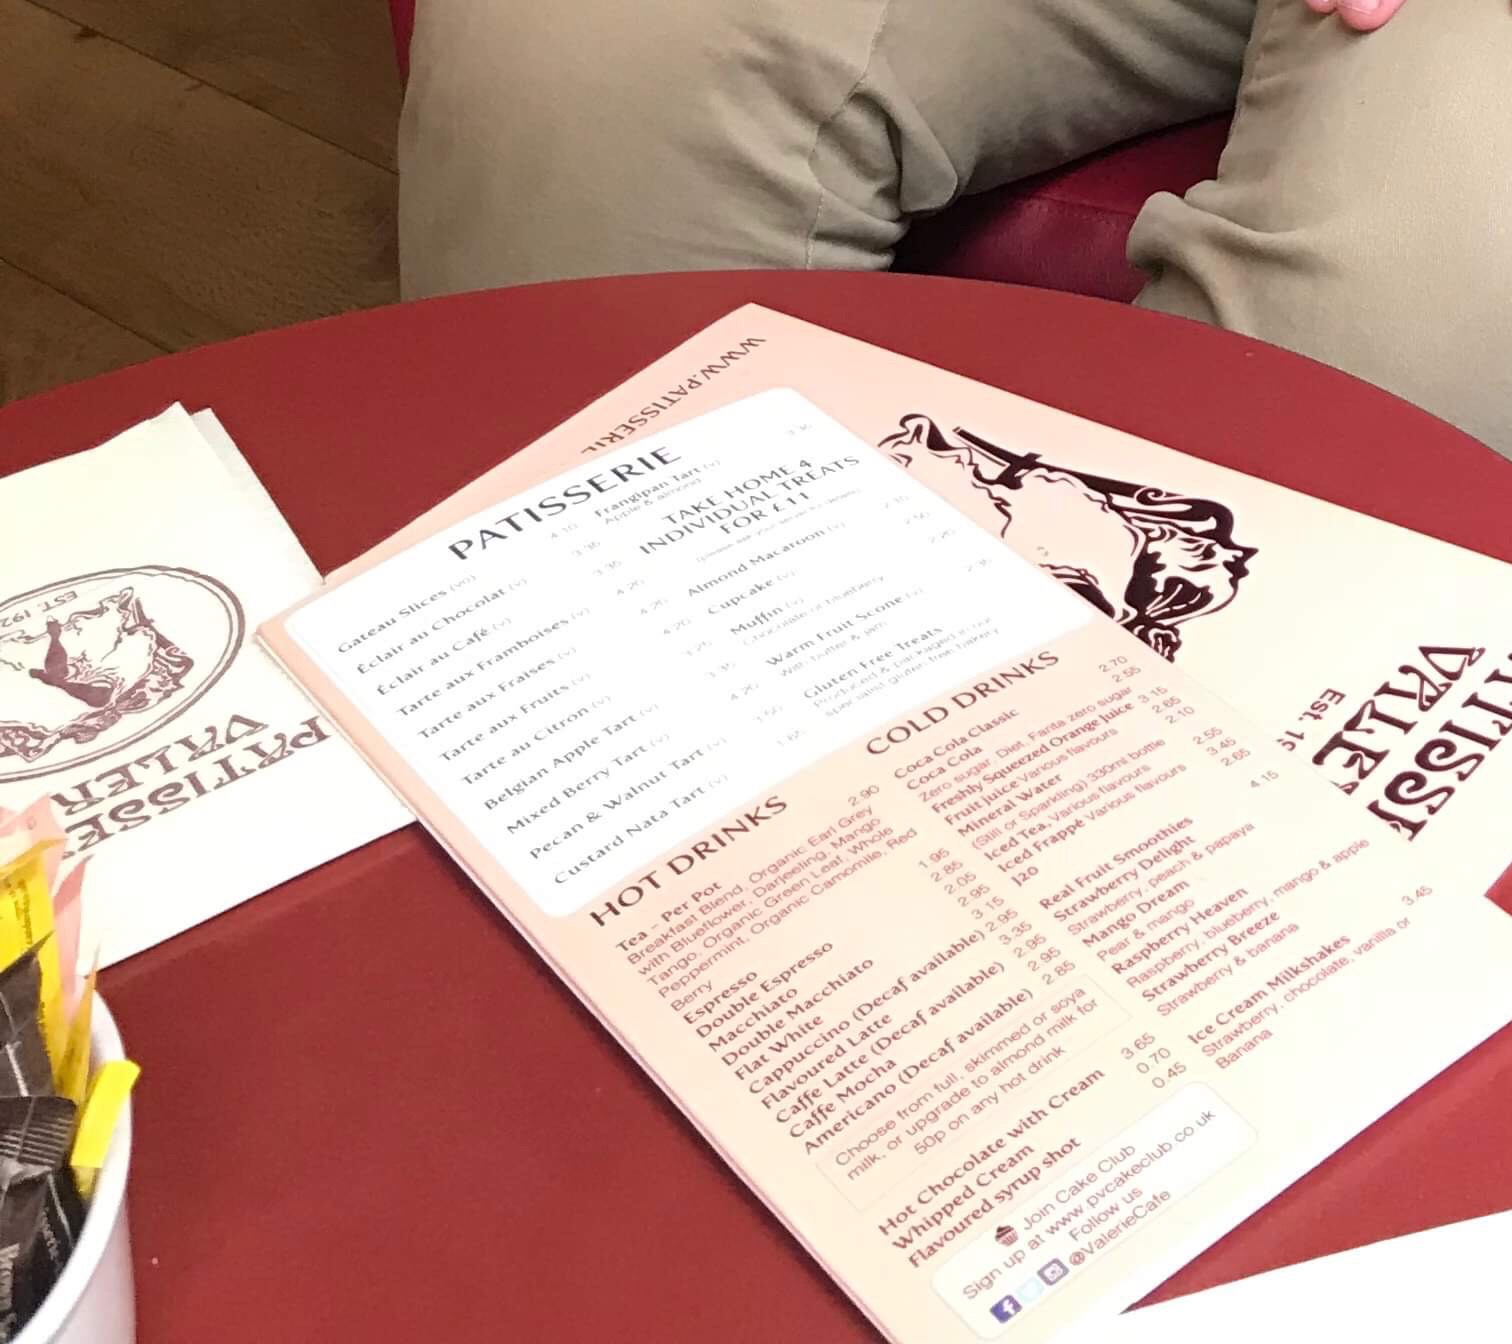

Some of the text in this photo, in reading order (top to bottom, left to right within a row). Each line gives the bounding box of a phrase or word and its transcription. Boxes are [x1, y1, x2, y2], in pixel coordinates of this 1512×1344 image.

[447, 445, 682, 561] PATISSERIE
[638, 490, 772, 554] INDIVIDUAL
[778, 457, 860, 491] TREATS
[662, 495, 717, 524] TAKE
[723, 466, 793, 499] HOME
[799, 459, 812, 468] 4
[718, 500, 765, 536] FOR
[0, 602, 33, 628] 192
[337, 590, 447, 653] Gateau Slices
[409, 630, 429, 645] au
[430, 588, 505, 631] Chocolat
[395, 619, 569, 716] Tarte aux Framboises
[429, 651, 450, 666] au
[417, 659, 555, 738] Tarte aux Fraises
[439, 685, 569, 761] Tarte aux Fruits
[865, 705, 949, 755] COLD
[950, 650, 1059, 709] DRINKS
[1299, 688, 1345, 723] Est.
[1311, 644, 1486, 796] VALE
[50, 714, 268, 817] VALER
[461, 706, 589, 785] Tarte au Citron
[483, 714, 637, 810] Belgian Apple Tart
[893, 709, 1019, 779] Coca Cola Classic
[905, 745, 983, 790] Coca Cola
[930, 781, 983, 814] Freshly
[981, 742, 1051, 784] Squeezed
[1048, 718, 1101, 747] Orange
[62, 715, 332, 861] PATISSE
[505, 745, 647, 834] Mixed Berry Tart
[528, 748, 704, 860] Pecan & Walnut Tart
[943, 779, 1020, 826] Fruit juice
[956, 773, 1062, 837] Mineral Water
[553, 786, 705, 884] Custard Nata Tart
[588, 795, 787, 927] HOT DRINKS
[982, 835, 1020, 861] Iced
[996, 847, 1034, 873] Iced
[1038, 816, 1193, 910] Real Fruit Smoothies
[614, 881, 722, 951] Tea Per Pot
[1052, 835, 1196, 922] Strawberry Delight
[1080, 880, 1190, 948] Mango Dream
[1110, 887, 1248, 975] Raspberry Heaven
[1141, 911, 1280, 1002] Strawberry Breeze
[682, 971, 758, 1025] Espresso
[694, 942, 833, 1038] Double Espresso
[707, 987, 798, 1052] Macchiato
[720, 958, 873, 1066] Double Macchiato
[1186, 935, 1351, 1045] Ice Cream Milkshakes
[733, 1015, 823, 1081] Flat White
[748, 1019, 850, 1094] Cappuccino
[760, 1013, 892, 1110] Flavoured Latte
[775, 1087, 822, 1123] Caffe
[821, 1053, 869, 1088] Latte
[788, 1058, 897, 1138] Caffe Mocha
[804, 1082, 897, 1155] Americano
[877, 1069, 1105, 1236] Hot Chocolate with Cream
[1022, 1144, 1136, 1231] Join Cake Club
[890, 1144, 1035, 1249] Whipped Cream
[907, 1137, 1081, 1268] Flavoured syrup shot
[1067, 1187, 1143, 1242] Follow us
[1068, 1190, 1171, 1266] @ValerieCafe
[961, 1267, 1002, 1300] Sign
[1002, 1248, 1026, 1269] up
[1026, 1233, 1046, 1250] at
